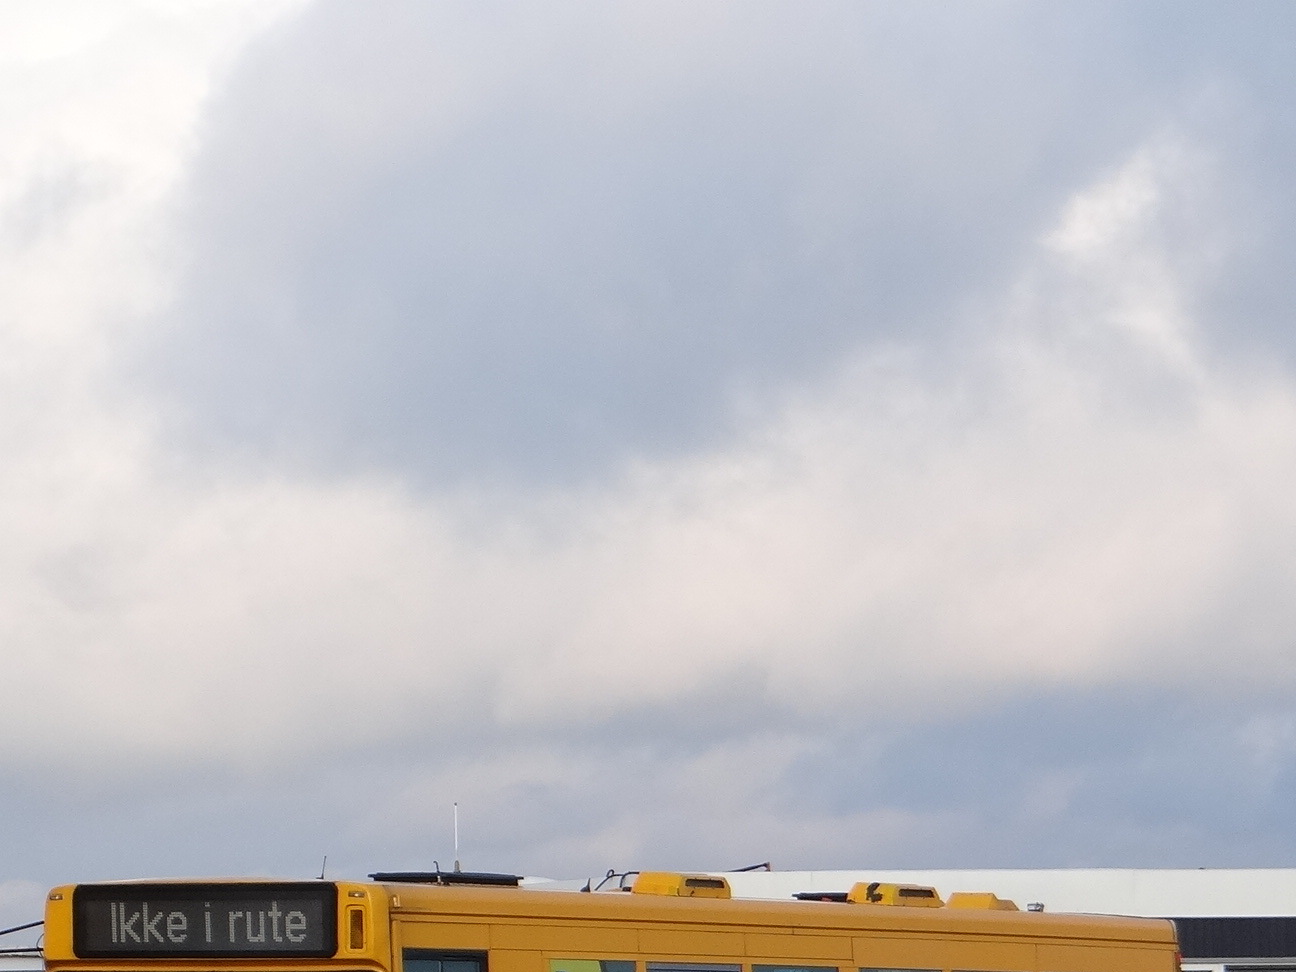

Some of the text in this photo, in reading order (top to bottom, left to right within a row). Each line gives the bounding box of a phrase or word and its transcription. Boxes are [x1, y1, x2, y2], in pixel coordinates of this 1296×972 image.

[111, 901, 307, 943] Ikke i rute
